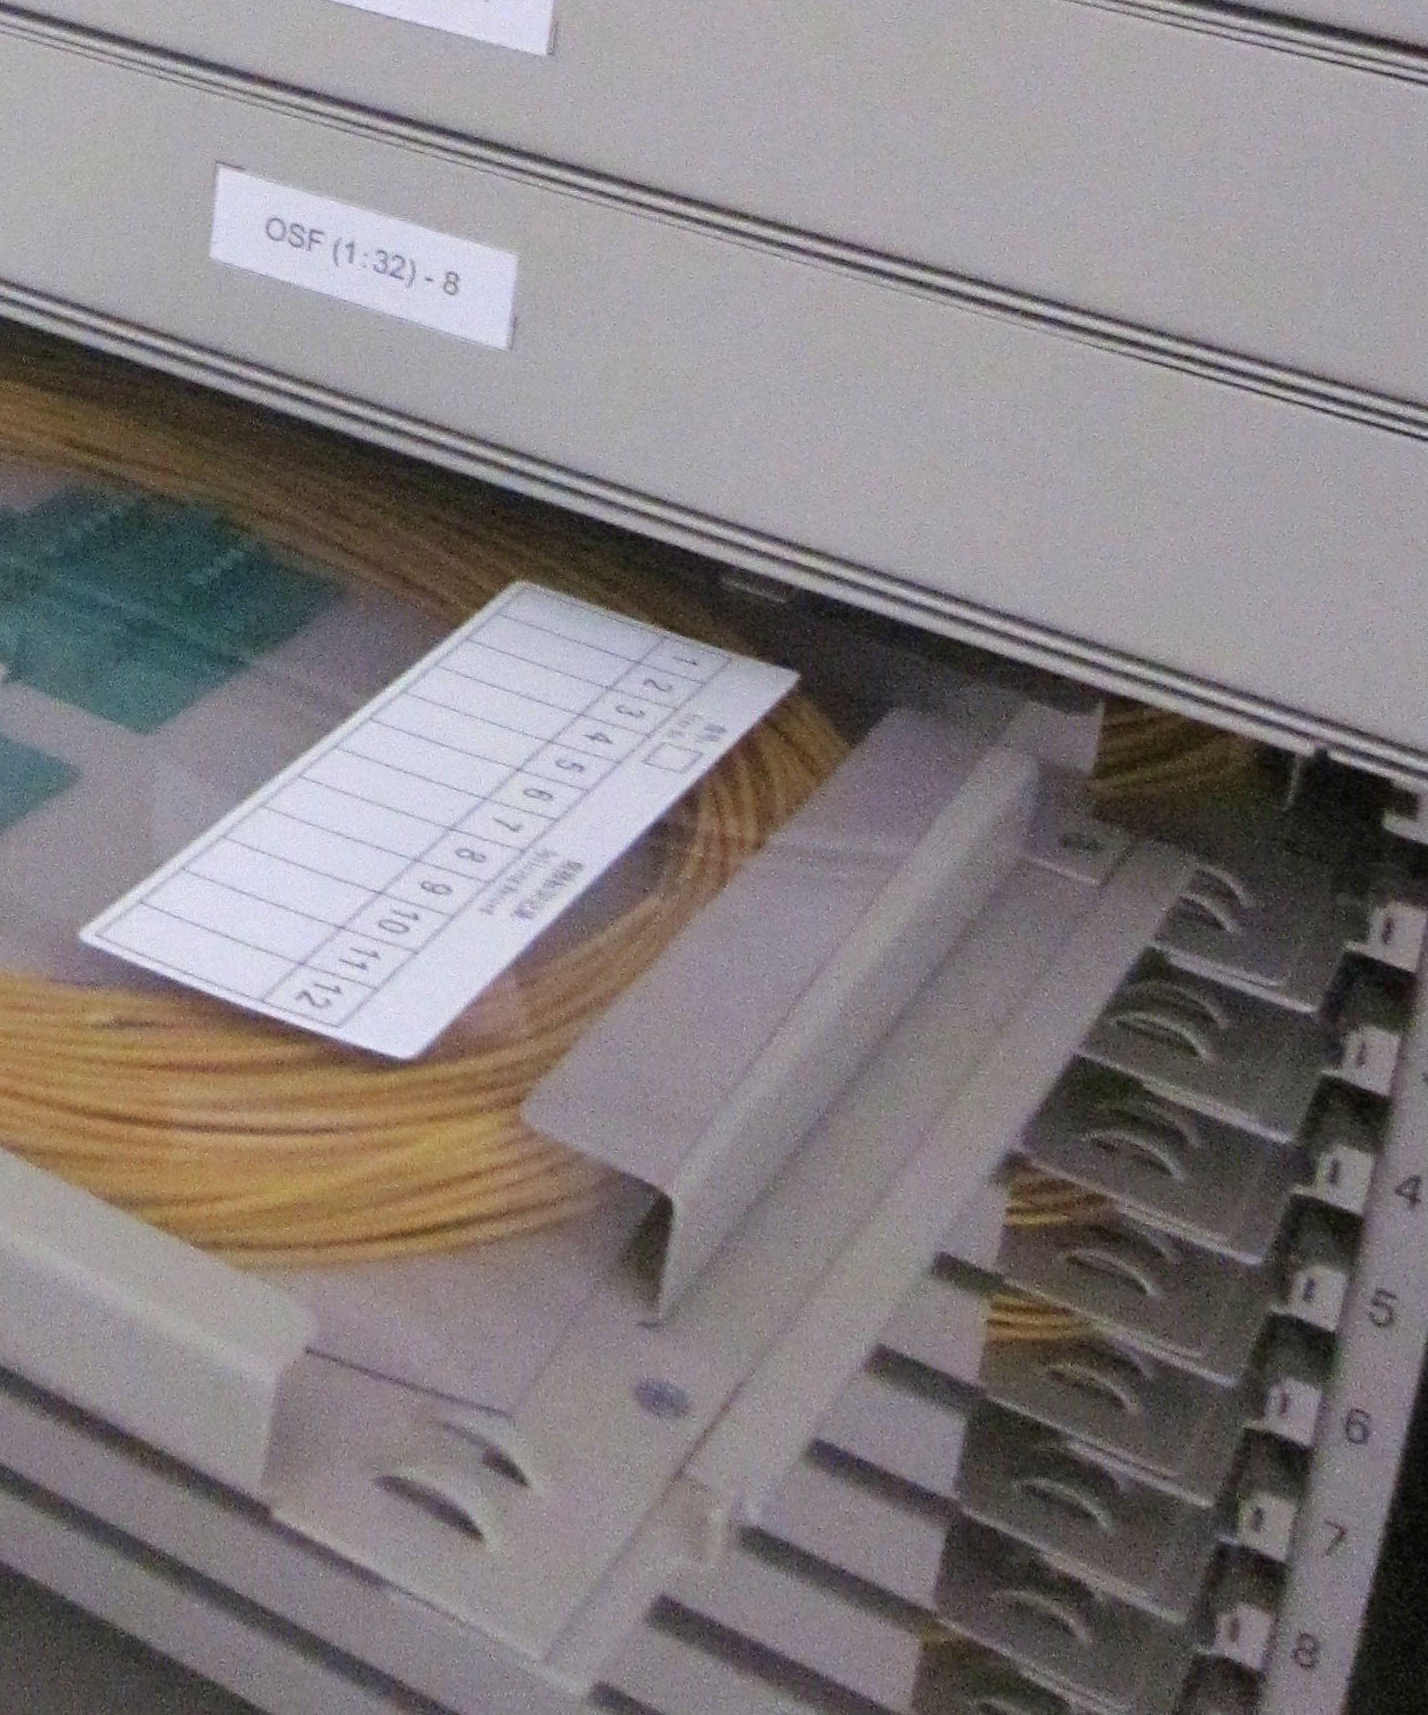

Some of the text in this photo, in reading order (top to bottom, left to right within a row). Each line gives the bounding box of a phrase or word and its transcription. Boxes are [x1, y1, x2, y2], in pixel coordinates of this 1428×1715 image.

[265, 217, 324, 252] OSF
[442, 271, 461, 296] 8
[294, 655, 699, 1010] 1 2 3 4 5 6 7 8 9 10 11 12
[1394, 1174, 1422, 1209] 4
[1369, 1288, 1397, 1328] 5
[1343, 1408, 1371, 1446] 6
[1323, 1518, 1347, 1556] 7
[1292, 1632, 1320, 1669] 8
